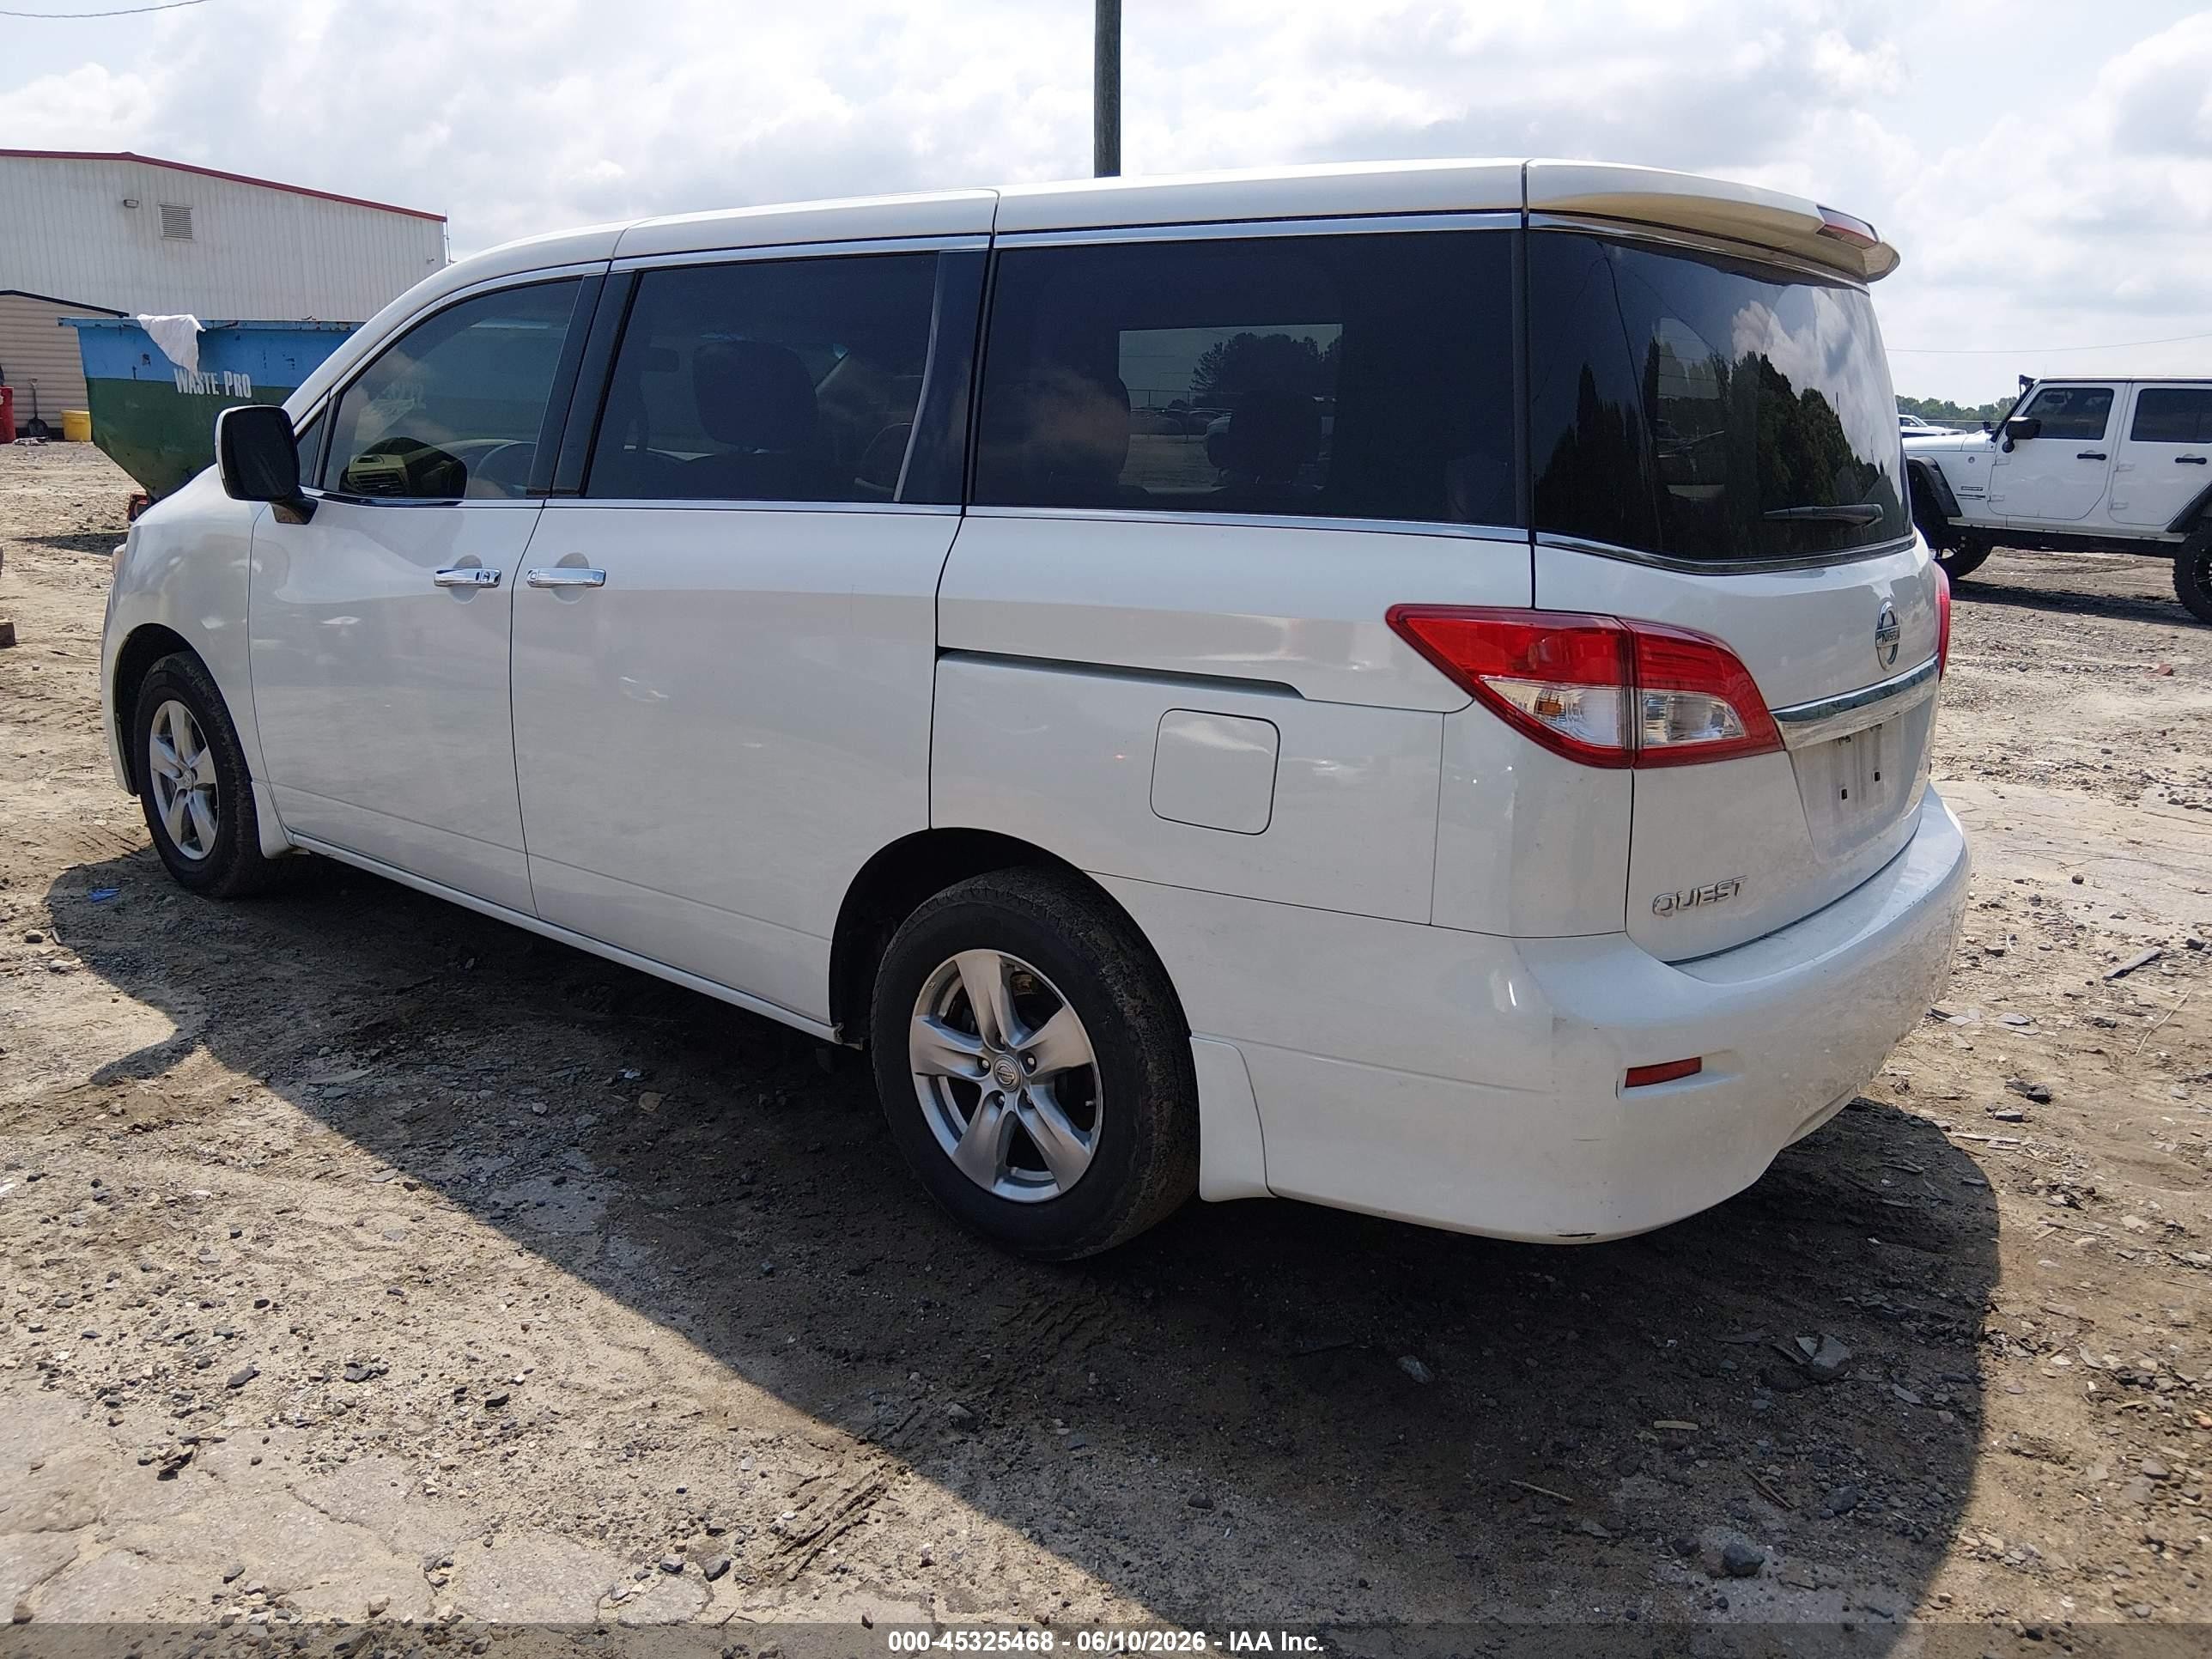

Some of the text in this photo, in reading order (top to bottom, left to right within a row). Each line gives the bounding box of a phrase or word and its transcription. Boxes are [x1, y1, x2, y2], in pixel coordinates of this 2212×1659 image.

[173, 368, 252, 398] WASTE PRO
[1652, 875, 1748, 917] QUEST
